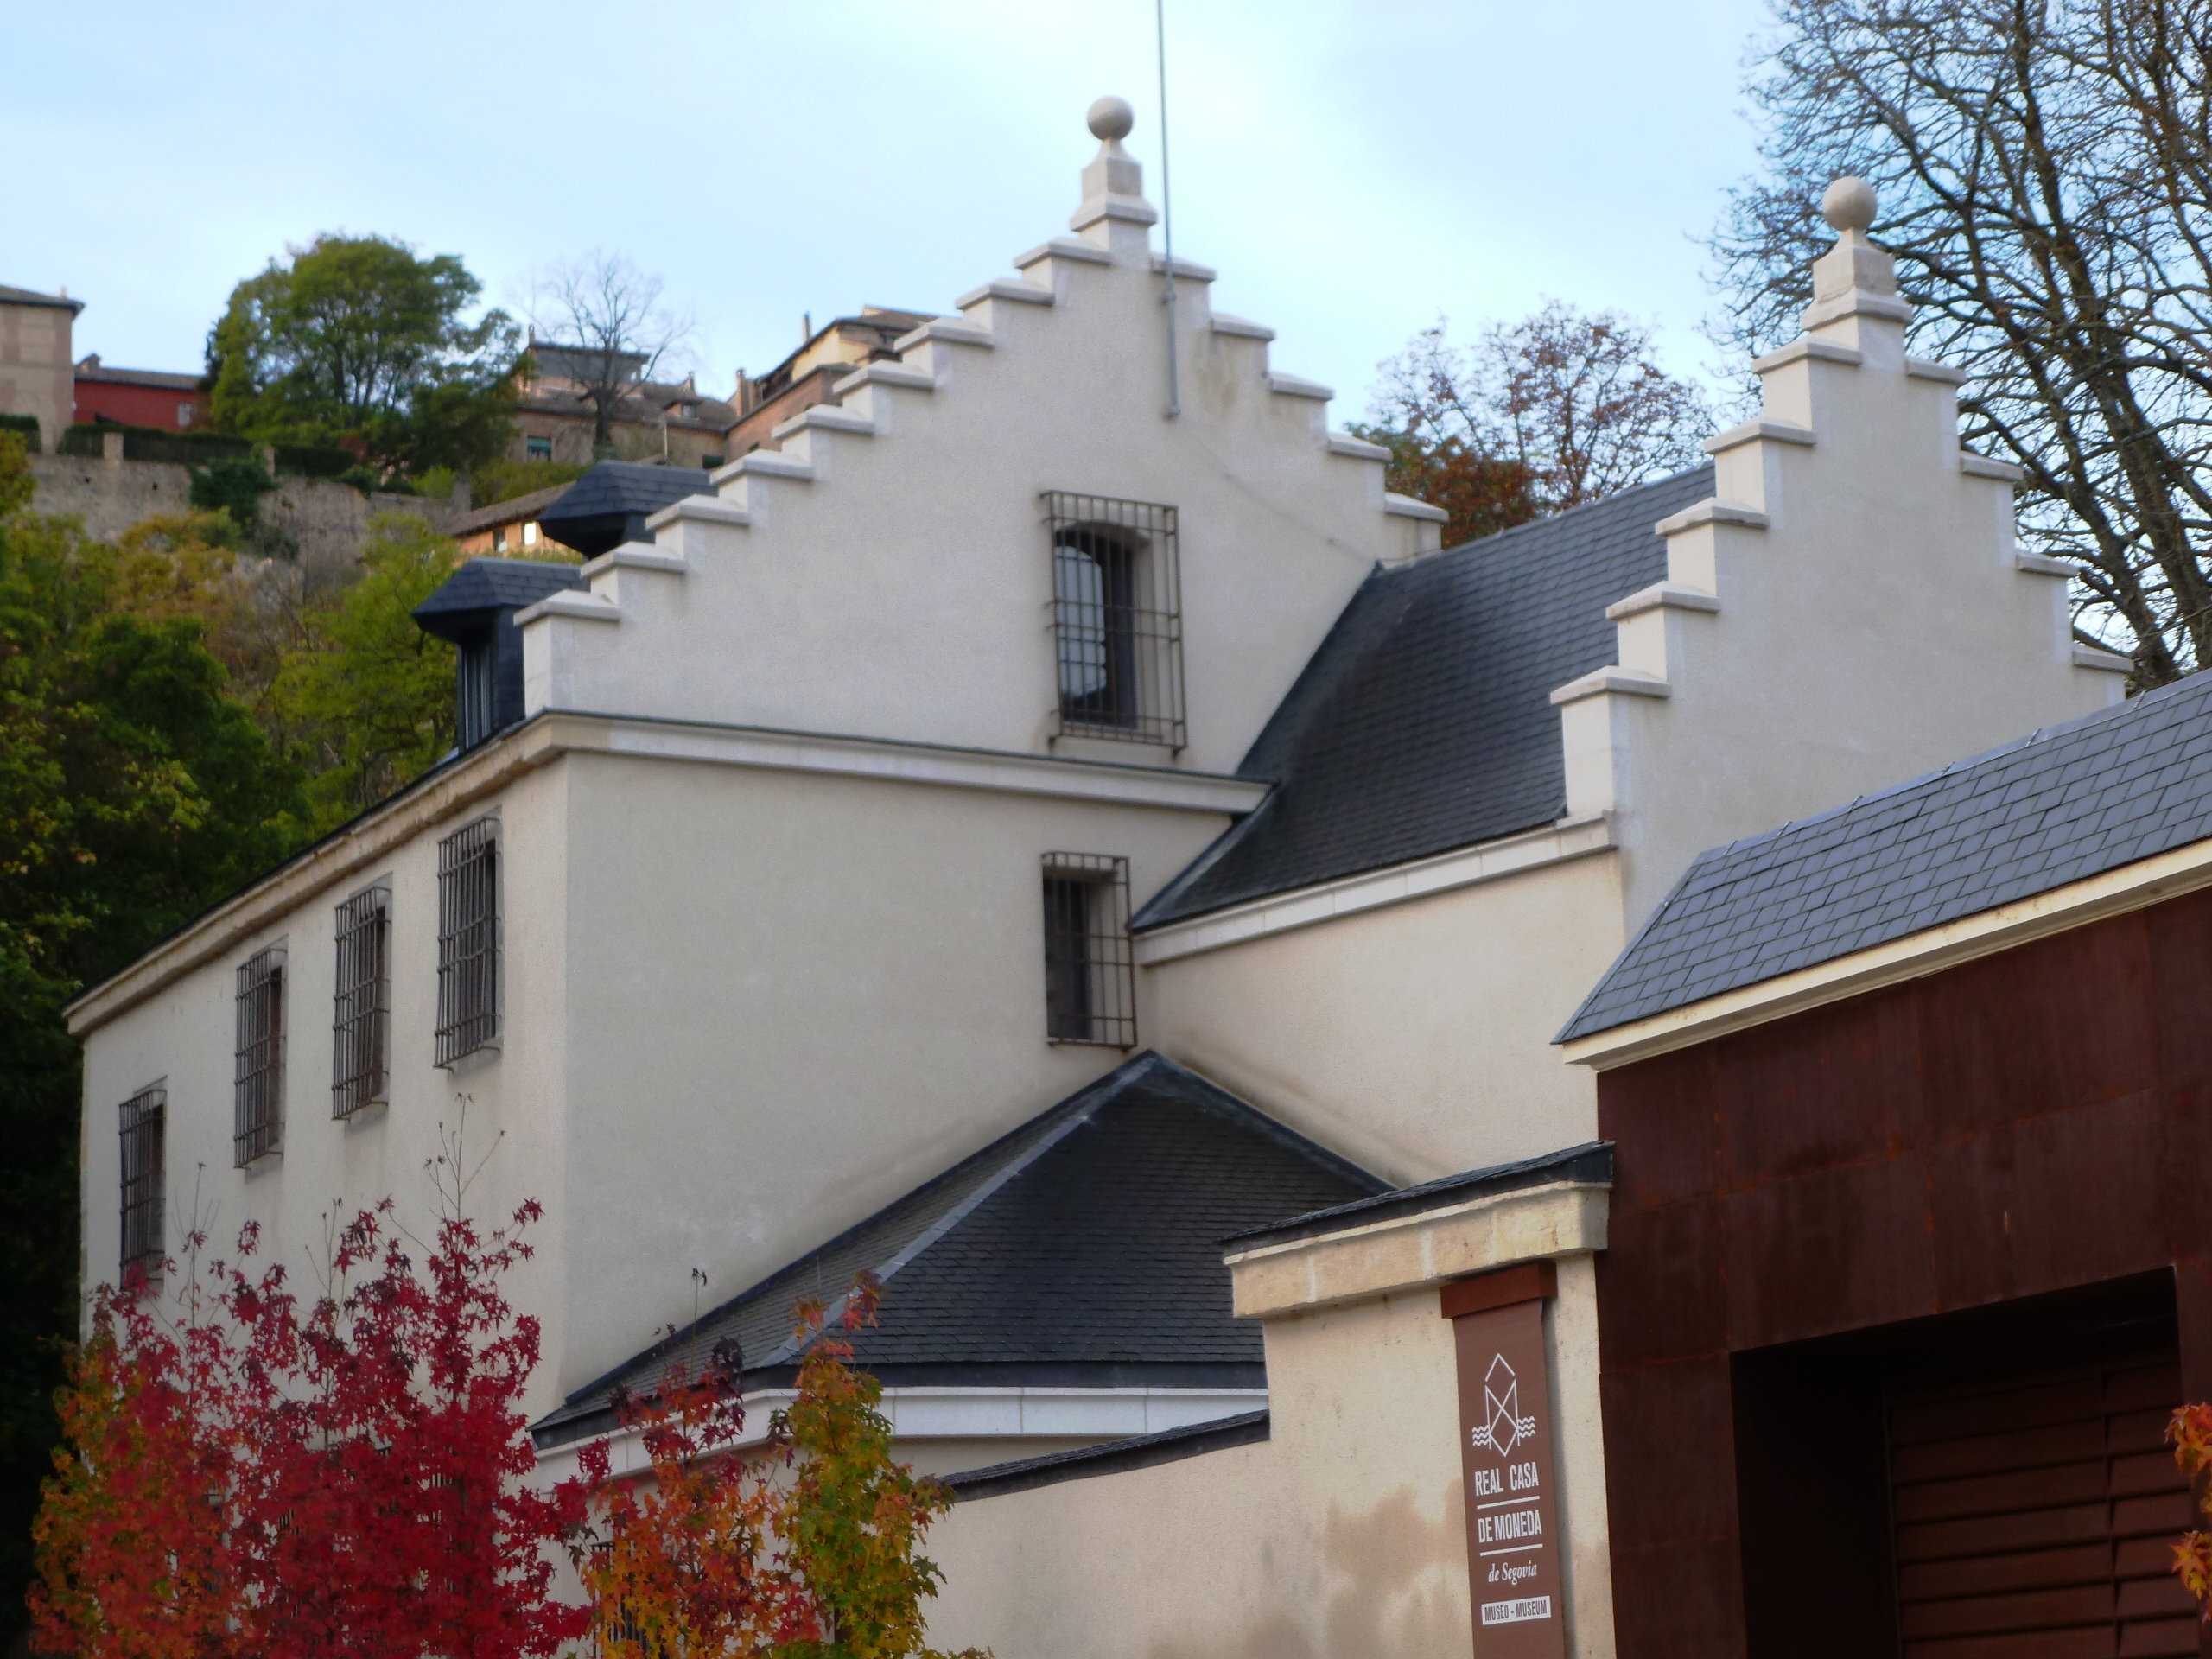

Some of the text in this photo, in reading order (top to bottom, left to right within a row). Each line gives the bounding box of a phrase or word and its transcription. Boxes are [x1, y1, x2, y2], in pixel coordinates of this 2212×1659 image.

[1474, 1461, 1540, 1497] REAL CASA
[1478, 1509, 1542, 1543] DE MONEDA
[1488, 1560, 1538, 1586] de Segovia
[1484, 1606, 1510, 1622] MUSEO
[1516, 1599, 1548, 1618] MUSEUM
